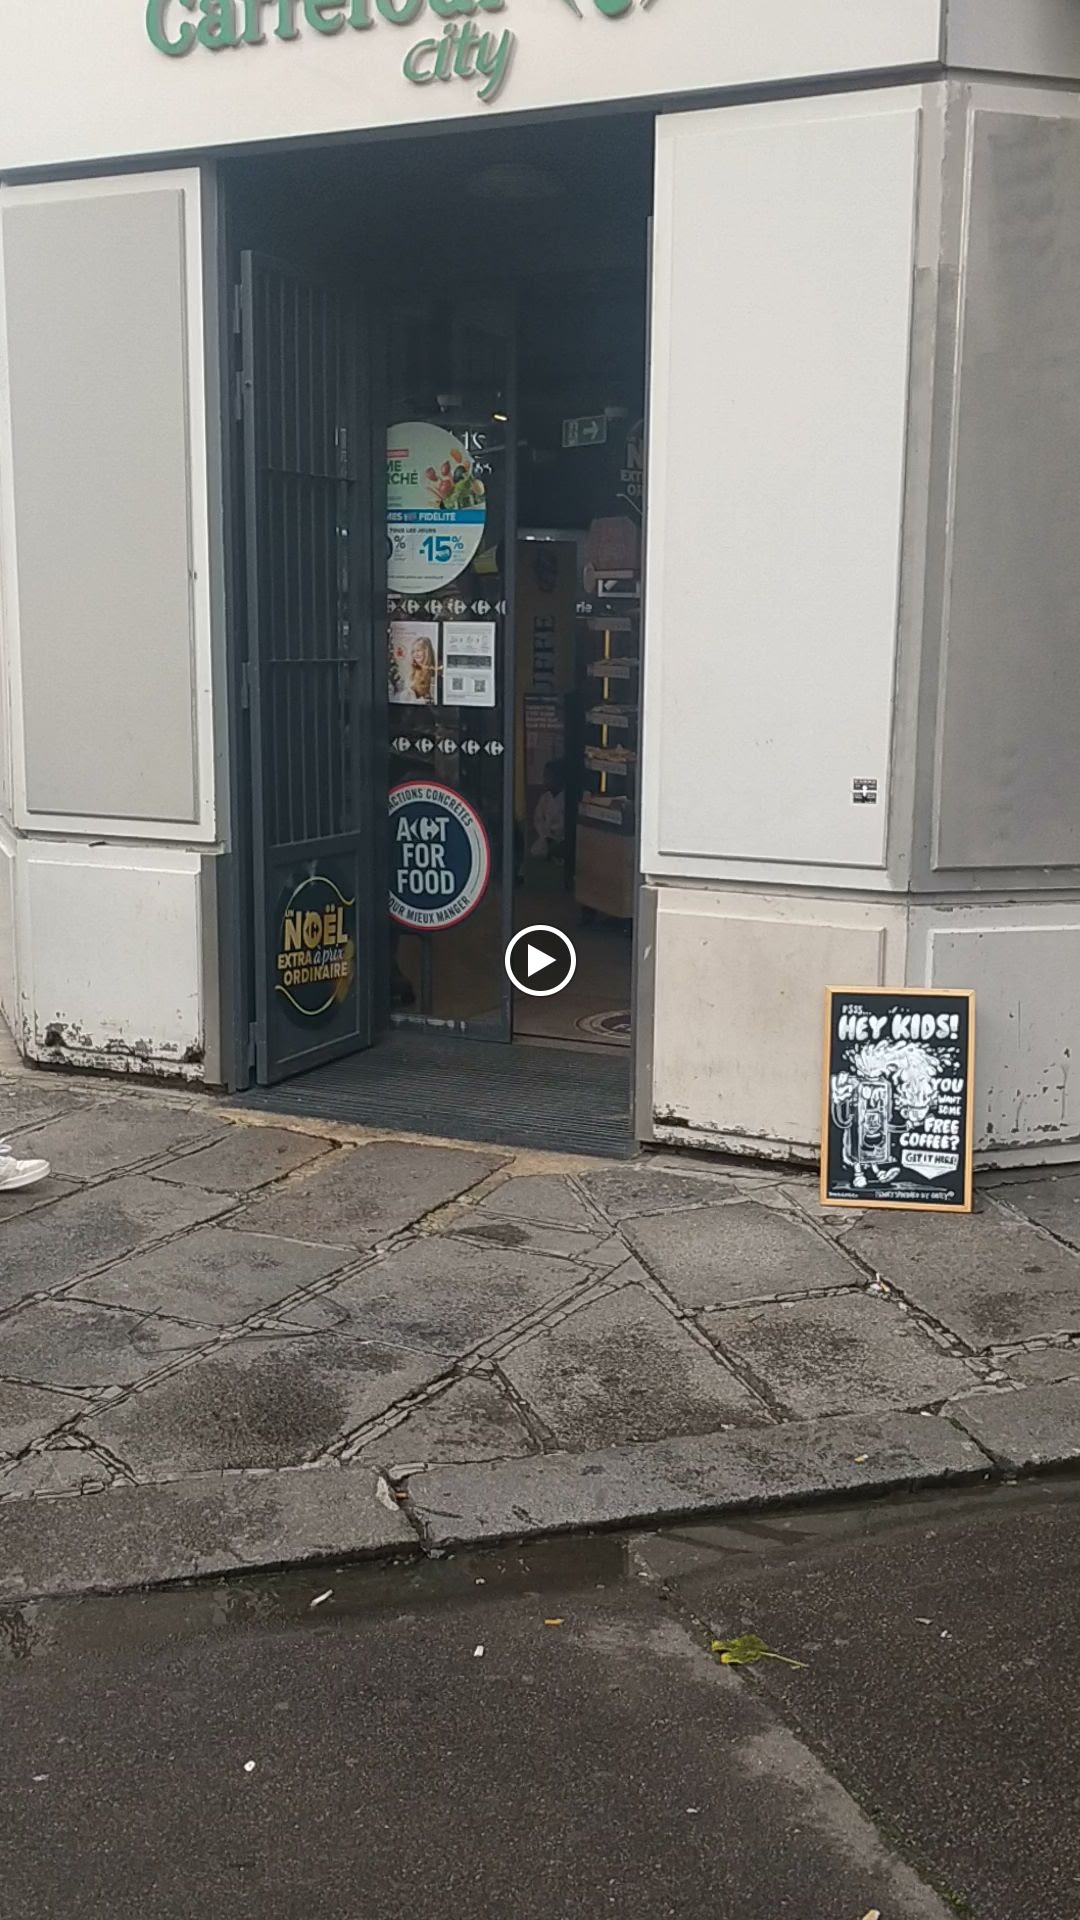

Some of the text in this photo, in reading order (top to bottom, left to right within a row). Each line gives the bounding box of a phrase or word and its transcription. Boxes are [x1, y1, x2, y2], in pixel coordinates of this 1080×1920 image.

[402, 20, 513, 101] city
[402, 843, 446, 868] FOR
[397, 869, 455, 895] FOOD
[406, 910, 435, 924] MIEUX
[436, 895, 471, 922] MANGER
[284, 904, 348, 950] NOËL
[277, 951, 312, 970] EXTRA
[321, 943, 345, 967] prix
[283, 961, 348, 986] ORDINAIRE
[838, 1013, 959, 1040] HEY KIDS!
[931, 1078, 964, 1093] YOU
[938, 1095, 962, 1105] WANT
[938, 1105, 961, 1116] SOME
[924, 1116, 960, 1134] FREE
[900, 1132, 960, 1150] COFFEE?
[905, 1152, 923, 1163] GET
